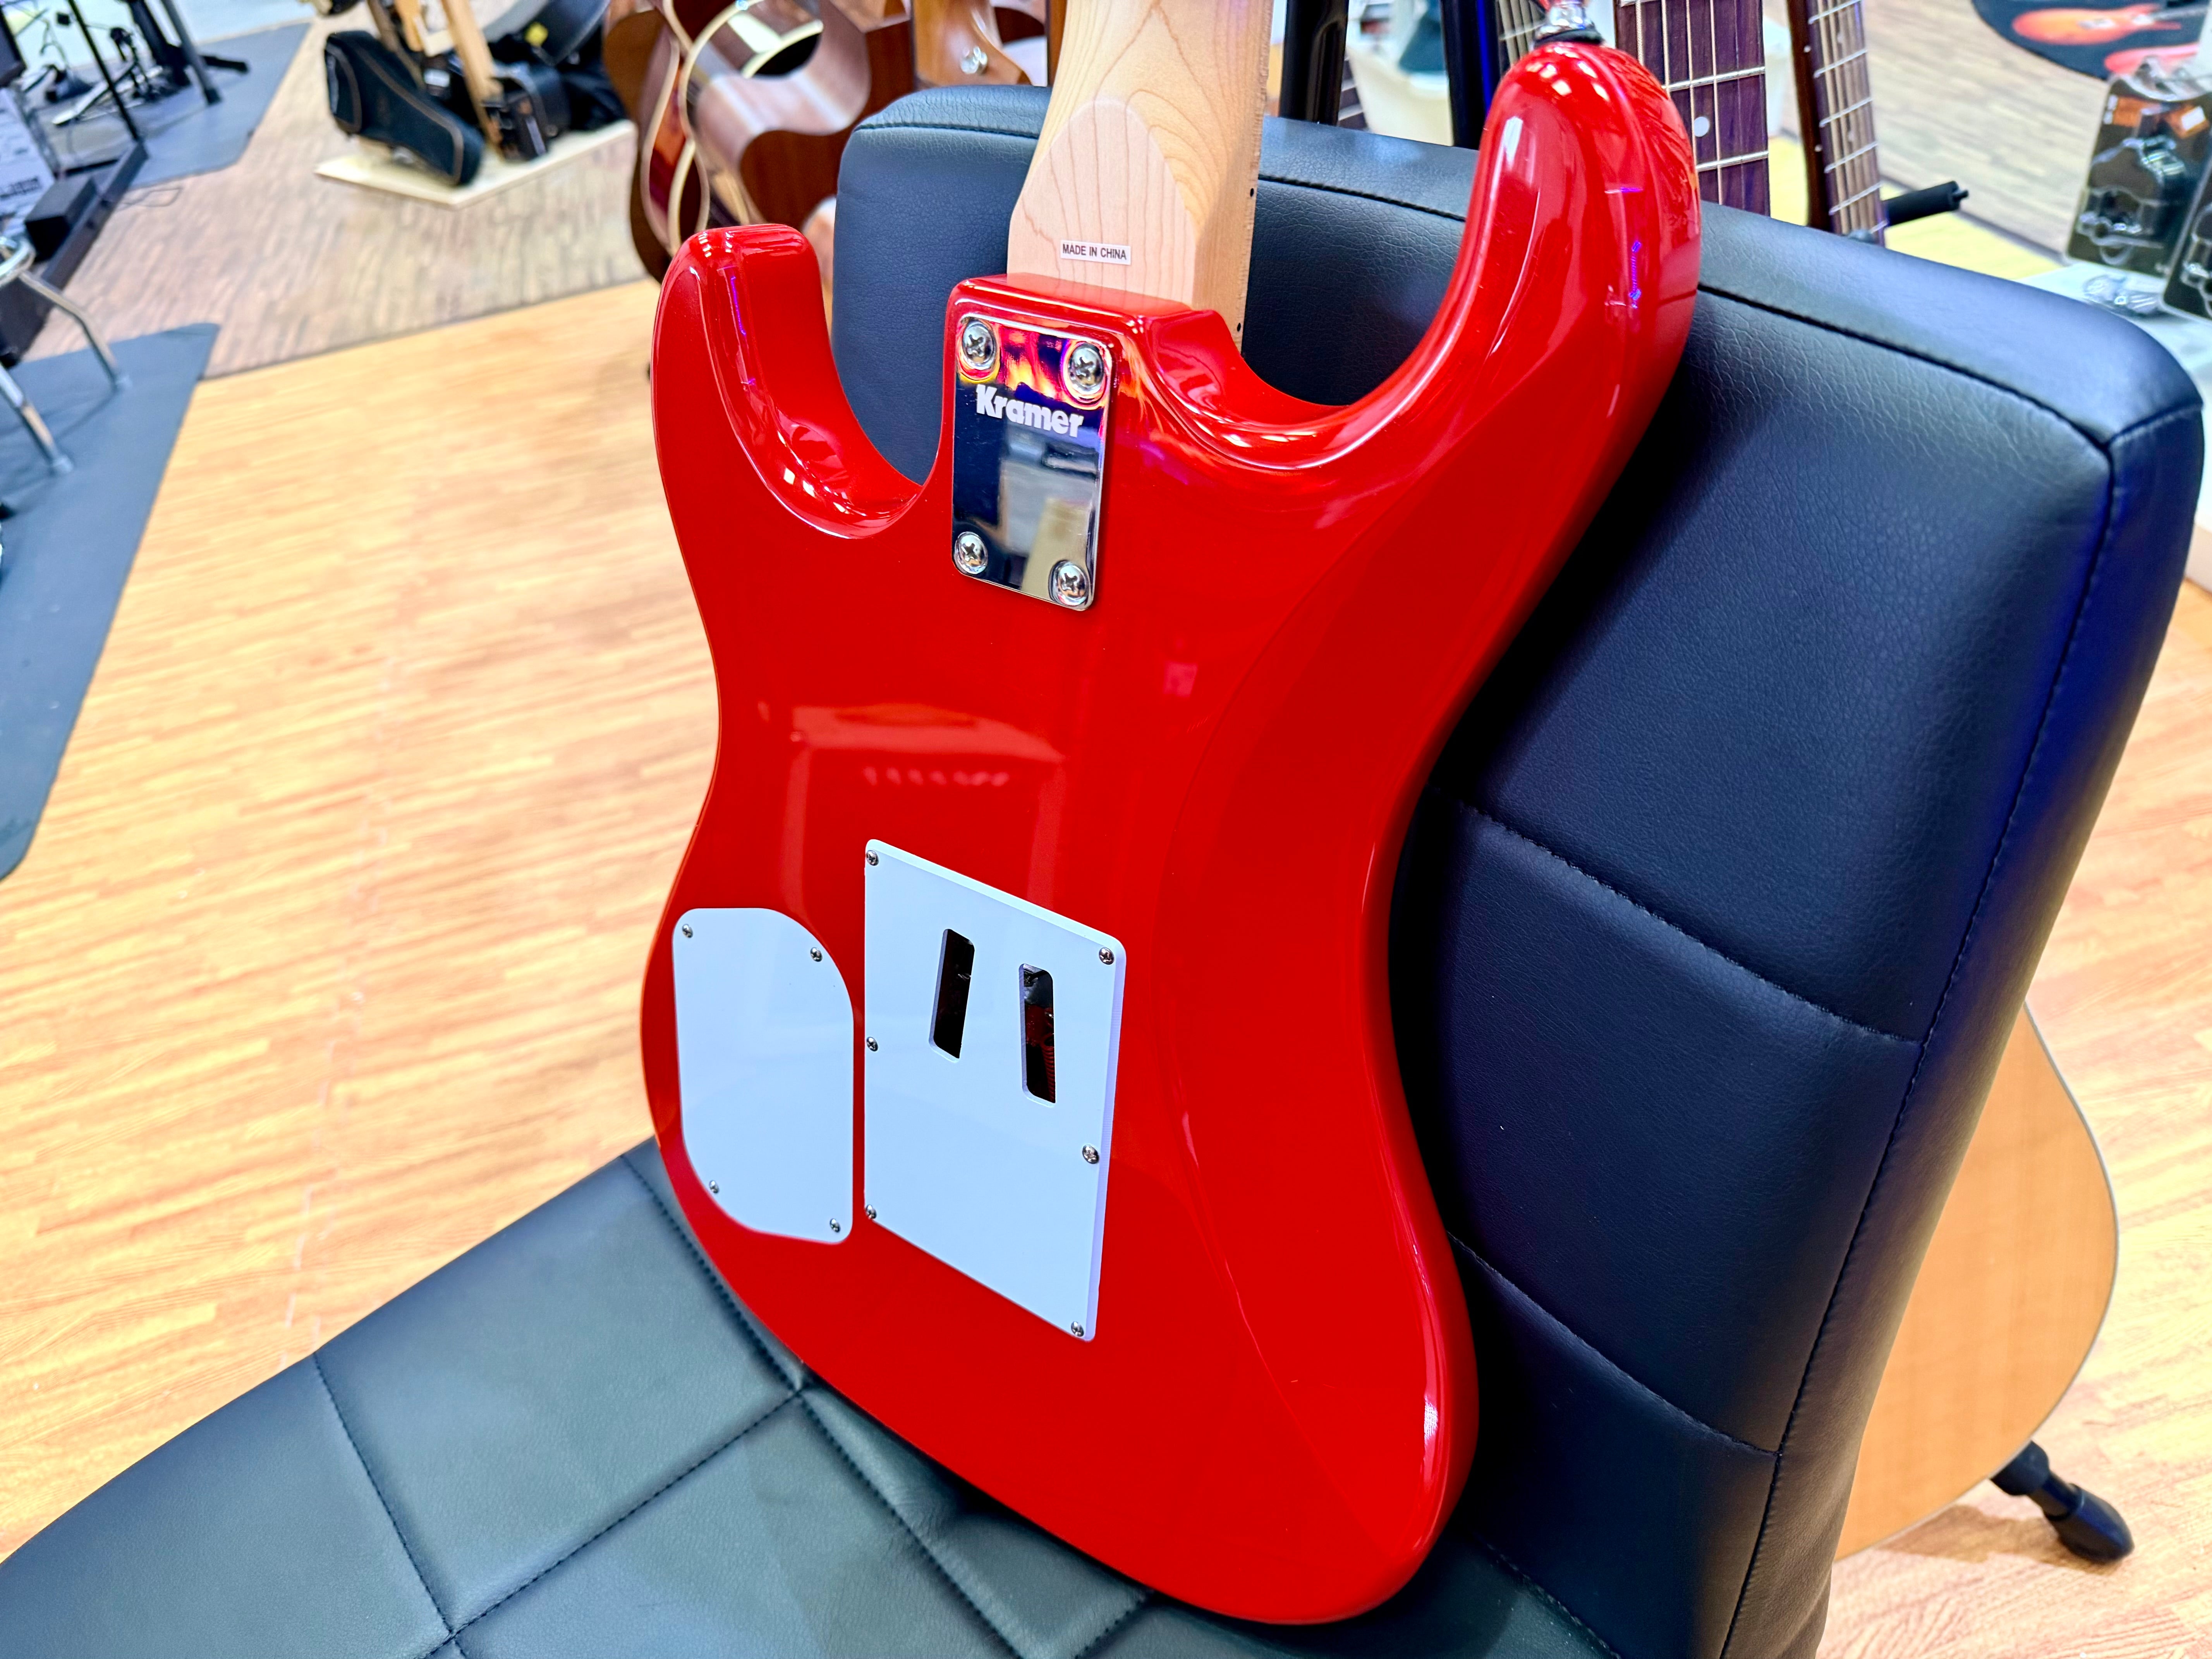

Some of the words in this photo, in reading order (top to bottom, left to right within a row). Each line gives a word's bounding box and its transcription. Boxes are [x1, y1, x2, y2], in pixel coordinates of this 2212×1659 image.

[1063, 244, 1086, 256] MADE
[1089, 246, 1097, 257] IN
[1101, 248, 1127, 260] CHINA
[976, 384, 1084, 438] Kramer
